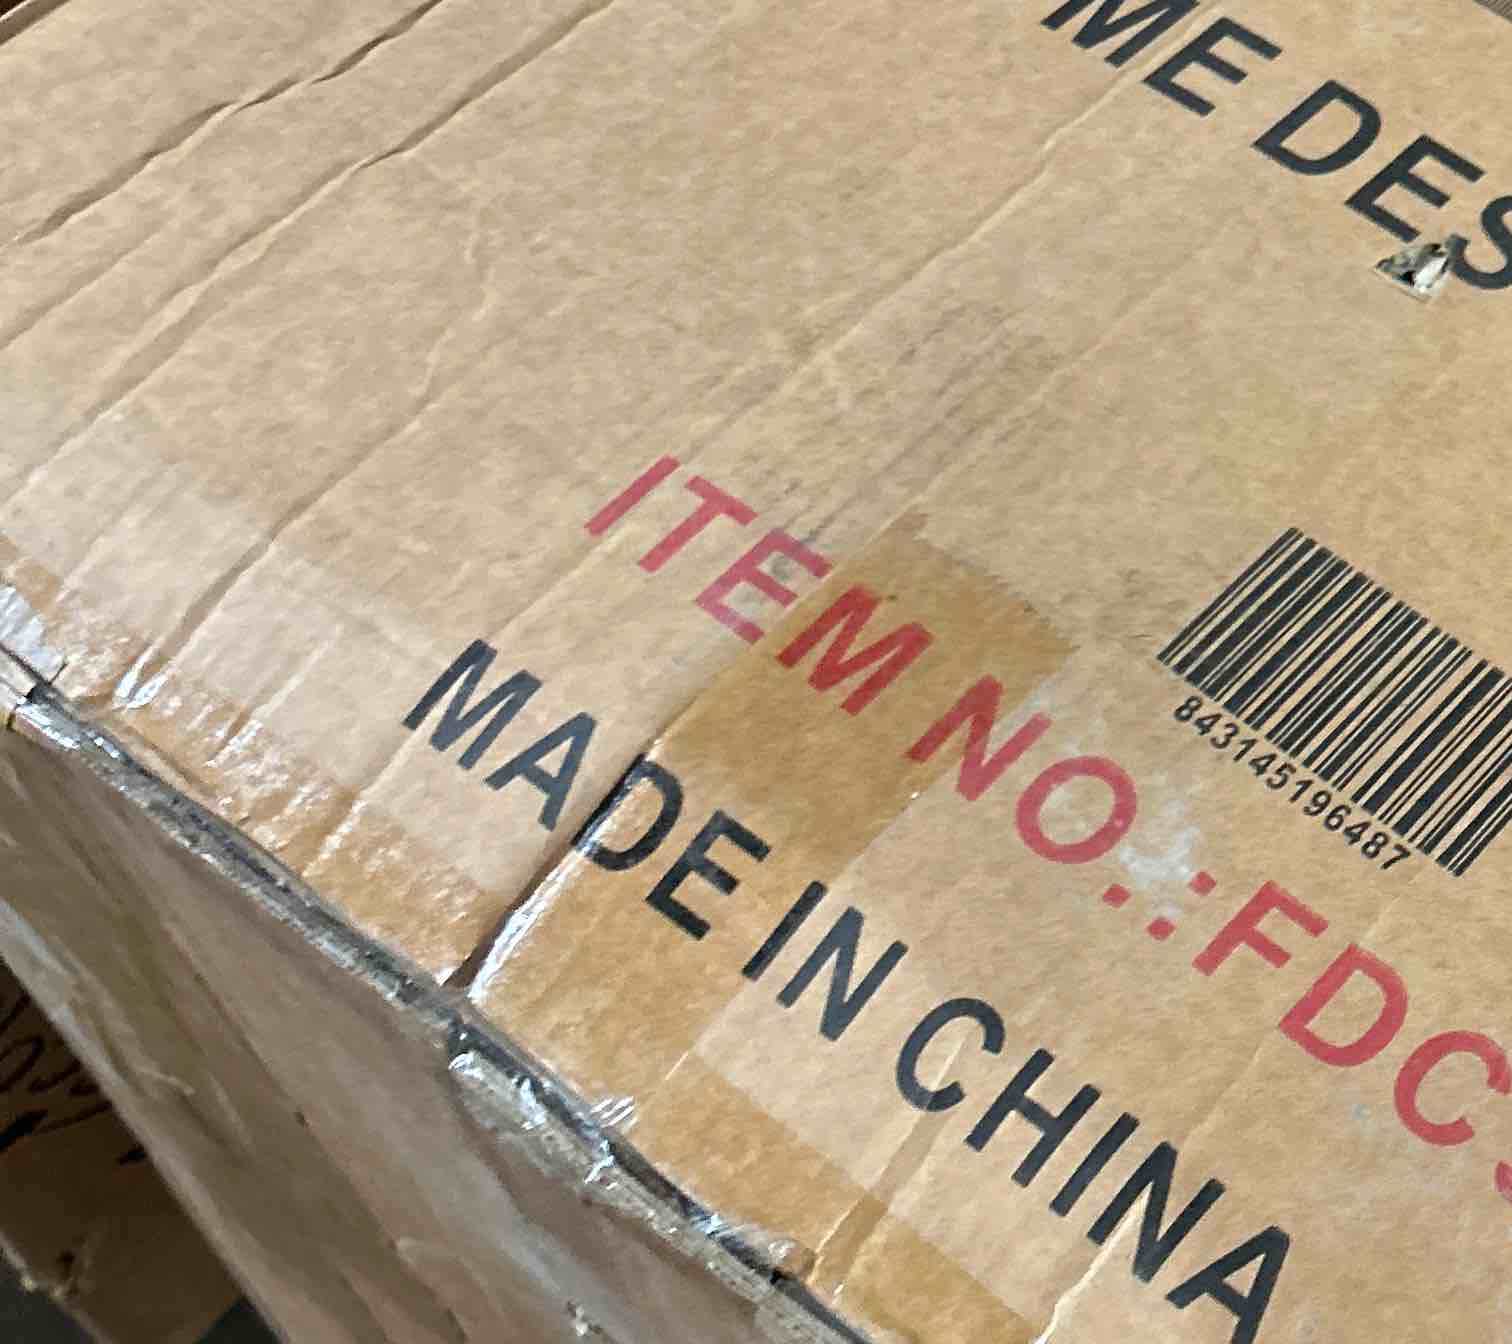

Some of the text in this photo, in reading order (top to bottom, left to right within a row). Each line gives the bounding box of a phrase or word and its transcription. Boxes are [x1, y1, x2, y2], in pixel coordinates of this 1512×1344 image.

[584, 456, 934, 716] ITEM
[401, 637, 772, 943] MADE
[741, 879, 909, 1041] IN
[1172, 694, 1412, 871] 843145196487
